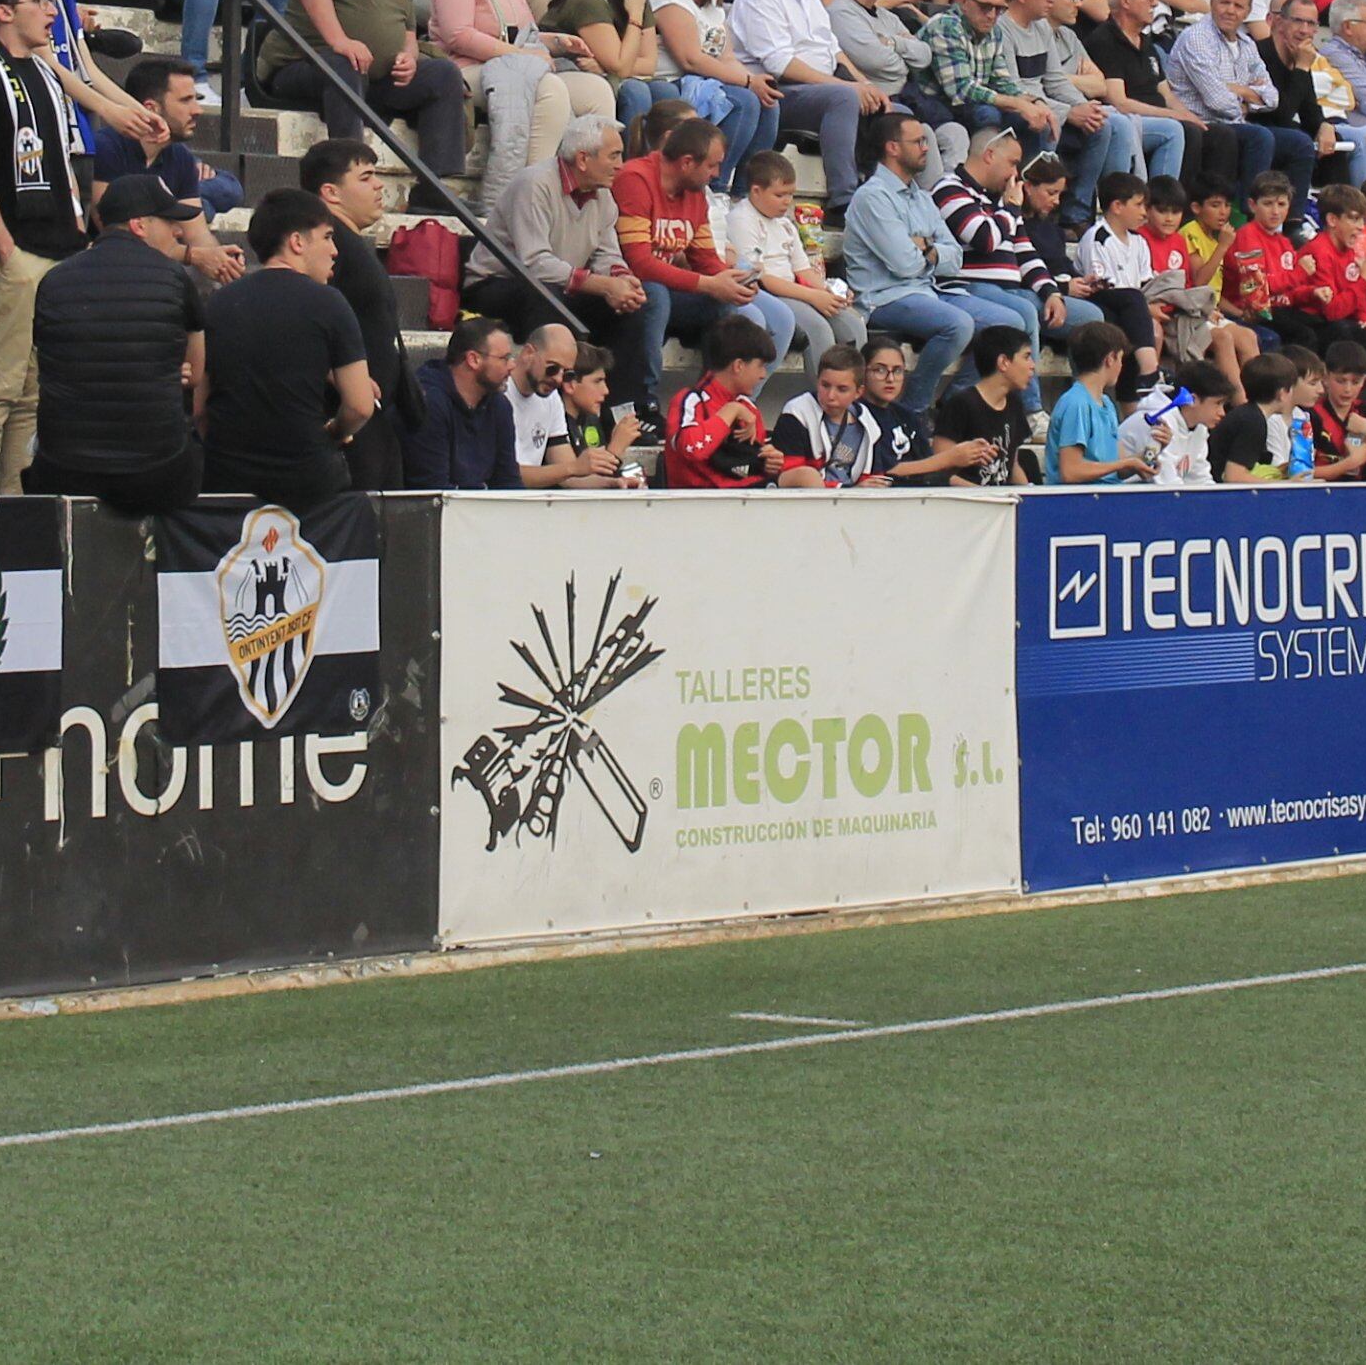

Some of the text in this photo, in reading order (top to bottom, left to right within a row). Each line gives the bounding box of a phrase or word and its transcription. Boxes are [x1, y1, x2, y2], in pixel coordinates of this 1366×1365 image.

[238, 625, 286, 660] ONTINYENT
[676, 666, 811, 704] TALLERES
[676, 712, 932, 810] MECTOR
[676, 810, 937, 849] CONSTRUCCIÓN DE MAQUINARIA
[1072, 815, 1106, 845] Tel:
[1111, 812, 1142, 840] 960
[1147, 810, 1175, 837] 141
[1179, 806, 1211, 834] 082
